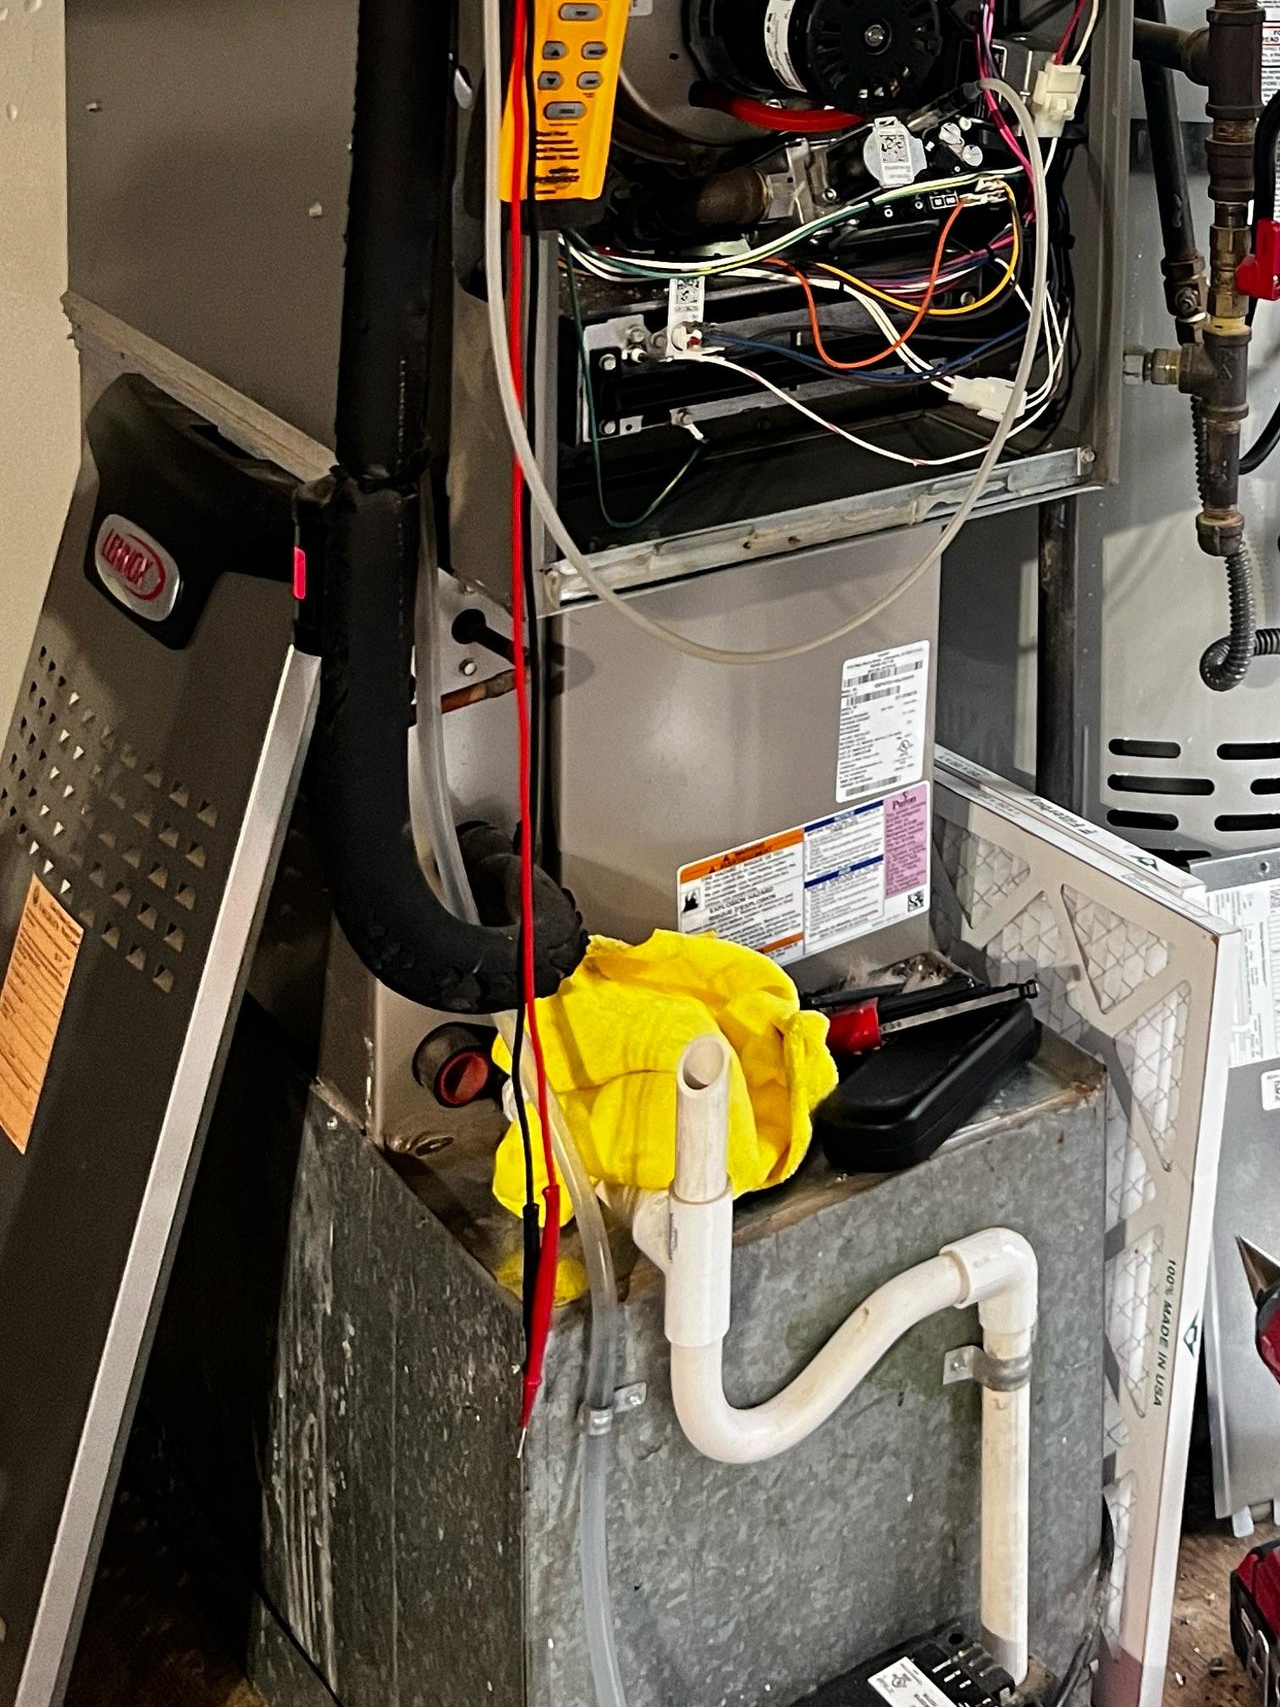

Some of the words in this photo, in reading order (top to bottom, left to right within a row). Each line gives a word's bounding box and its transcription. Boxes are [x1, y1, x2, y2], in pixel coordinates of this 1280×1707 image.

[101, 528, 153, 585] LENNOX
[1165, 1259, 1177, 1296] 100%
[1159, 1300, 1173, 1347] MADE
[1158, 1351, 1168, 1371] IN
[1153, 1373, 1165, 1406] USA
